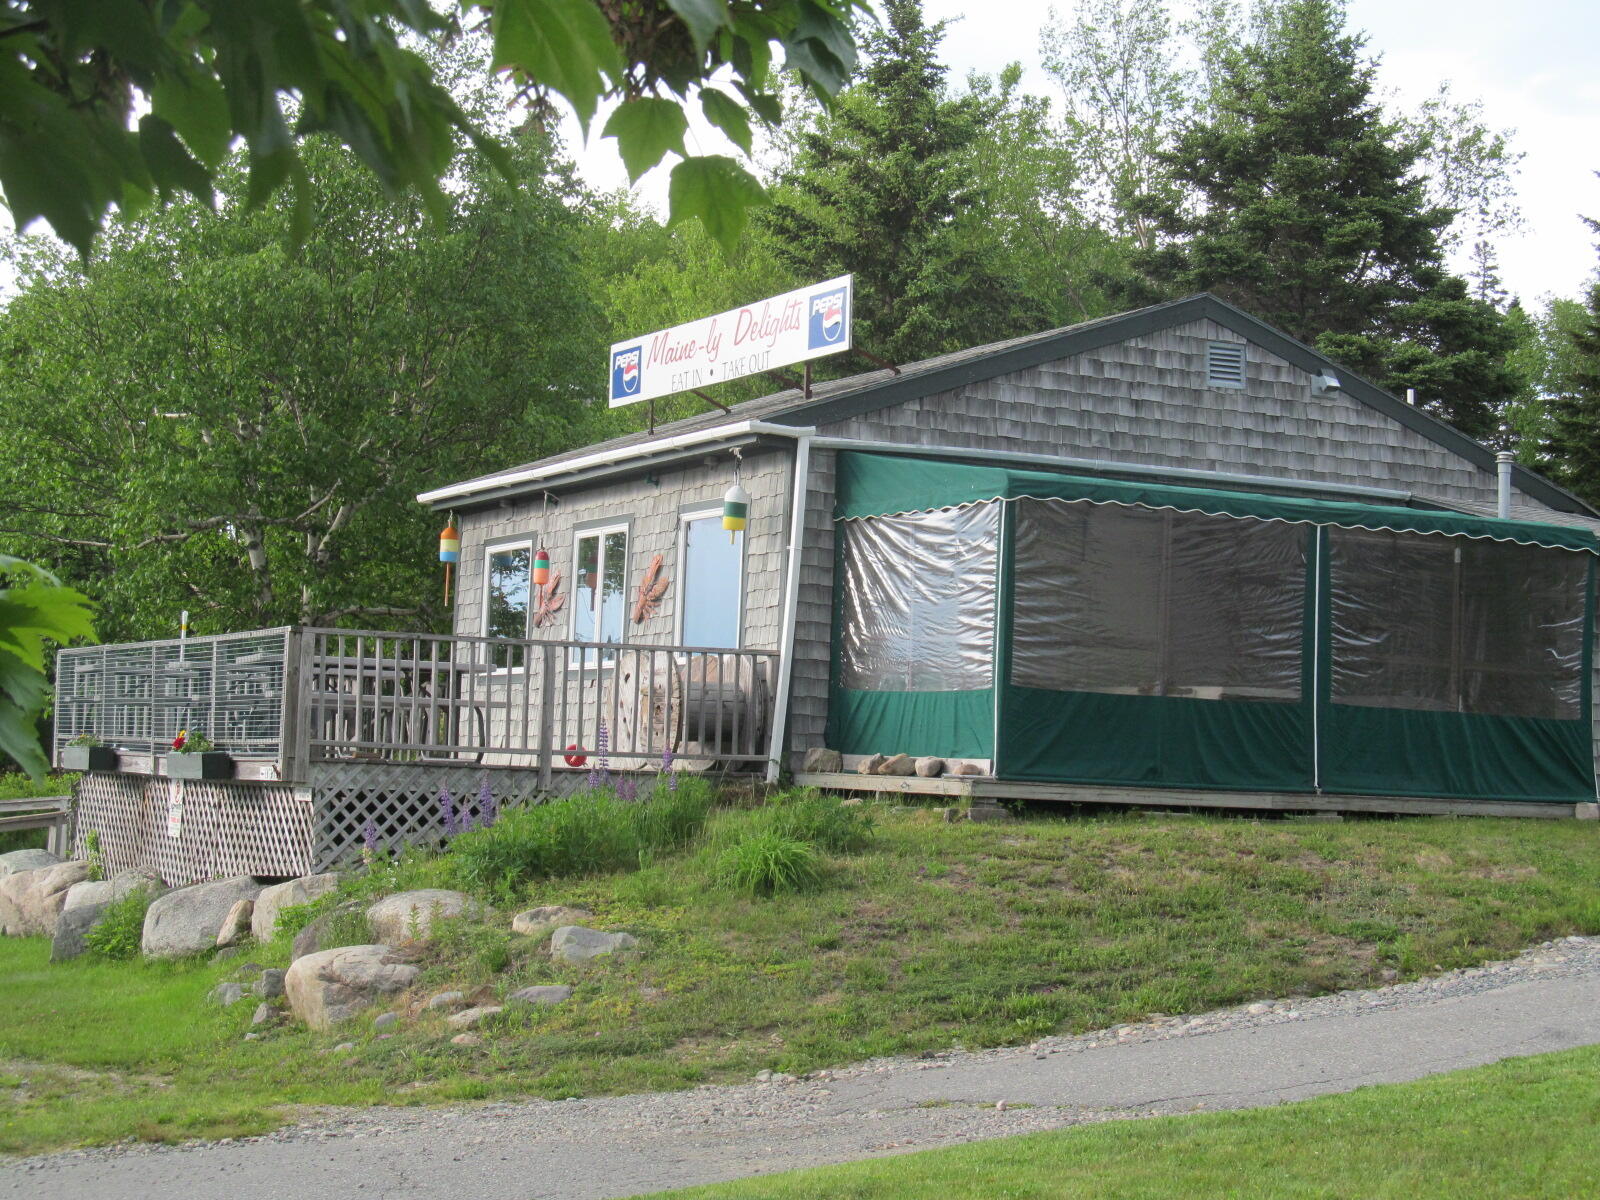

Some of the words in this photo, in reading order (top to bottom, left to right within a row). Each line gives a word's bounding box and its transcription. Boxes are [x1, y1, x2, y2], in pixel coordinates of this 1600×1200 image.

[812, 292, 843, 315] PEPSI
[647, 318, 723, 370] Maine-ly
[733, 300, 803, 348] Delights
[615, 350, 640, 370] PEPSI
[672, 371, 691, 391] EAT
[692, 368, 702, 386] IN
[722, 357, 746, 379] TAKE
[748, 350, 770, 373] OUT
